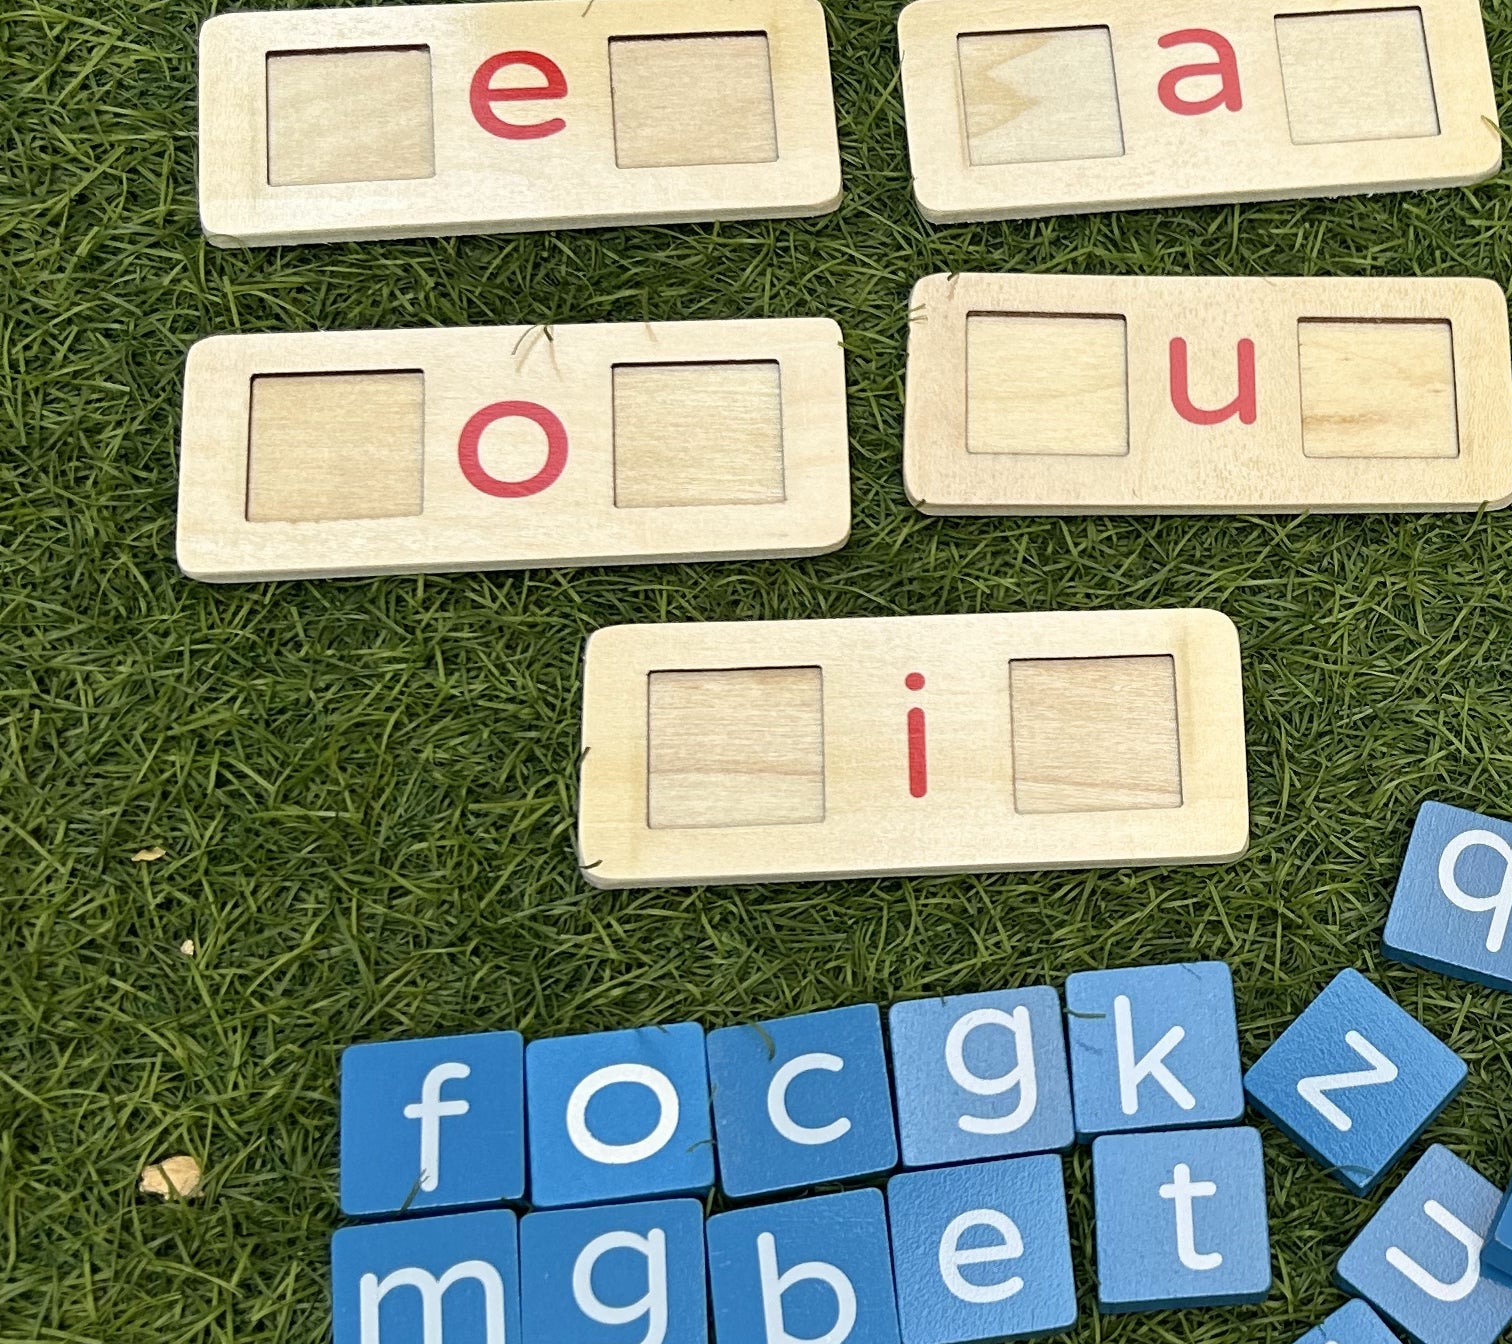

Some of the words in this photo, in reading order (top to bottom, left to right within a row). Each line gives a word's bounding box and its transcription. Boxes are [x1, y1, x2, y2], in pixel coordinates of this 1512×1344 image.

[469, 50, 568, 140] e
[1157, 28, 1242, 115] a
[1169, 337, 1257, 425] u
[457, 400, 568, 498] o
[905, 672, 927, 799] i
[403, 1062, 470, 1192] f
[566, 1063, 679, 1165] o
[767, 1052, 850, 1145] c
[944, 1005, 1038, 1135] g
[1113, 994, 1196, 1115] k
[938, 1208, 1024, 1304] e
[1158, 1163, 1223, 1271] t
